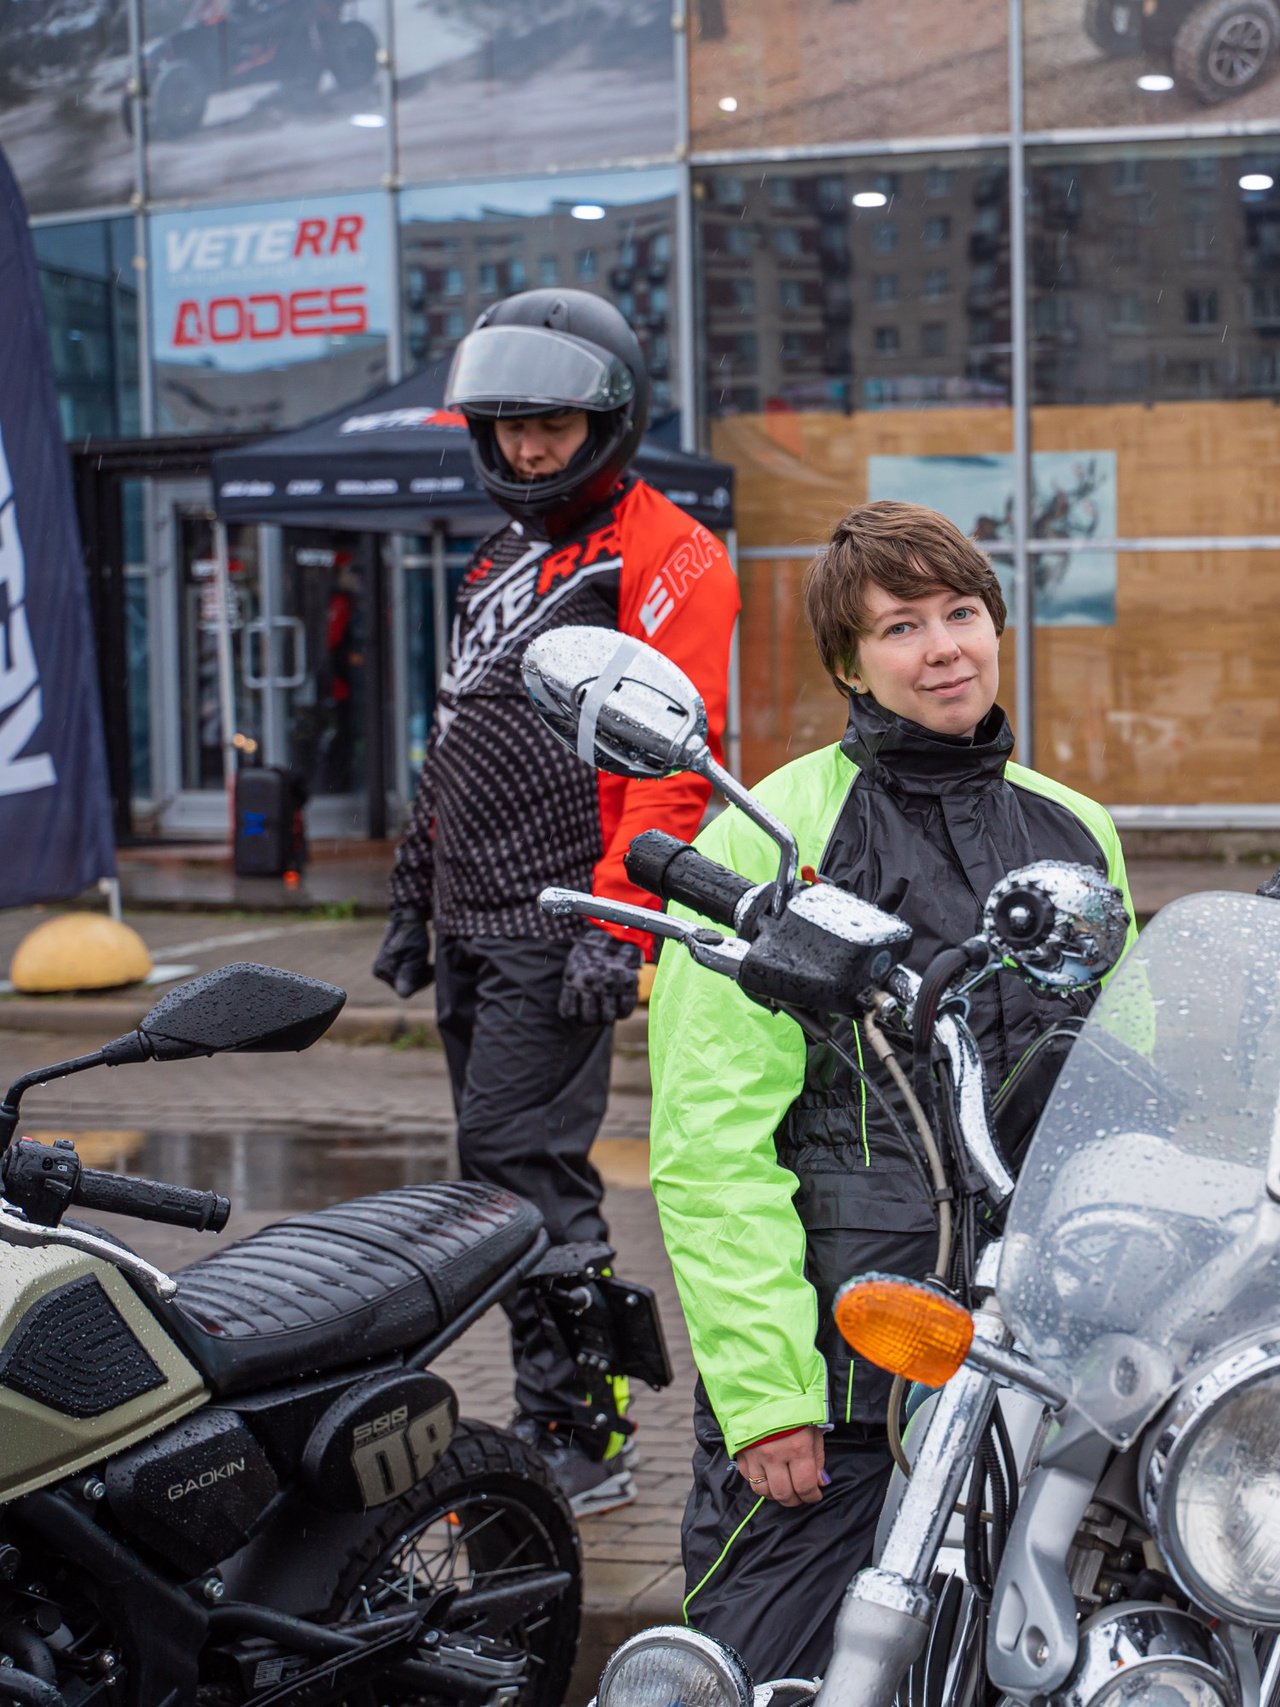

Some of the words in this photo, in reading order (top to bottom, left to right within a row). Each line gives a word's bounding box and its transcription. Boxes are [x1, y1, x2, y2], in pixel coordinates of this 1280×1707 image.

[166, 214, 365, 273] VETERR
[173, 285, 367, 347] AODES
[167, 1457, 245, 1501] GAOKIN
